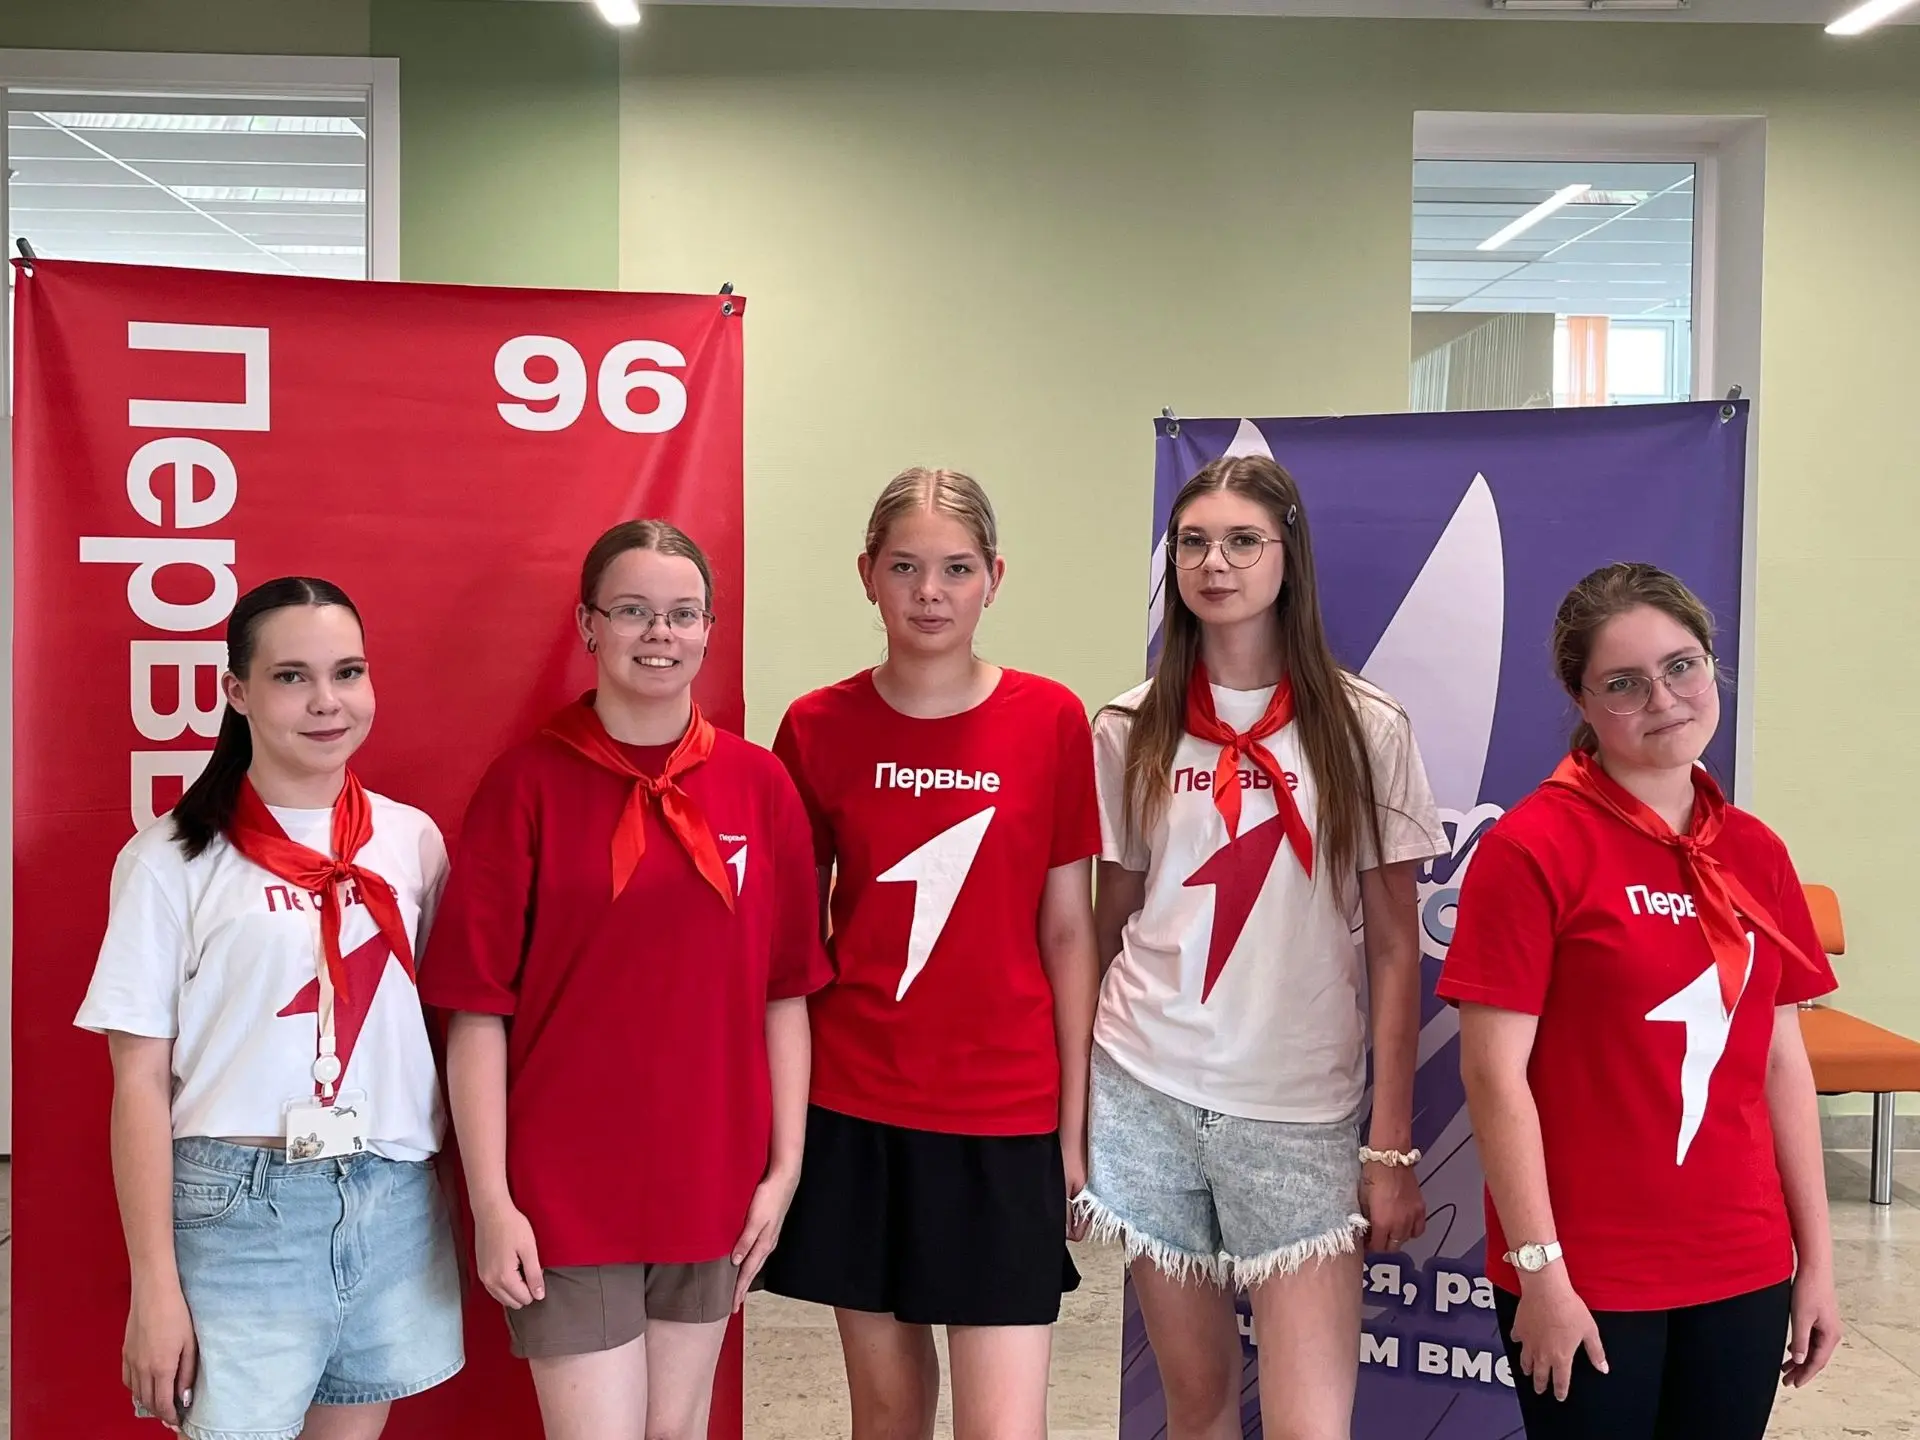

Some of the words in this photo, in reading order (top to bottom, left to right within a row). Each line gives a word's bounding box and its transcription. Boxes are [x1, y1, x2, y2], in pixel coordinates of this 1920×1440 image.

[493, 334, 688, 434] 96
[78, 320, 271, 840] Перв
[874, 761, 1001, 798] Первые
[1173, 766, 1299, 799] Певые
[1624, 884, 1698, 925] Перв
[1435, 1270, 1497, 1313] ра
[1417, 1341, 1516, 1389] вме
